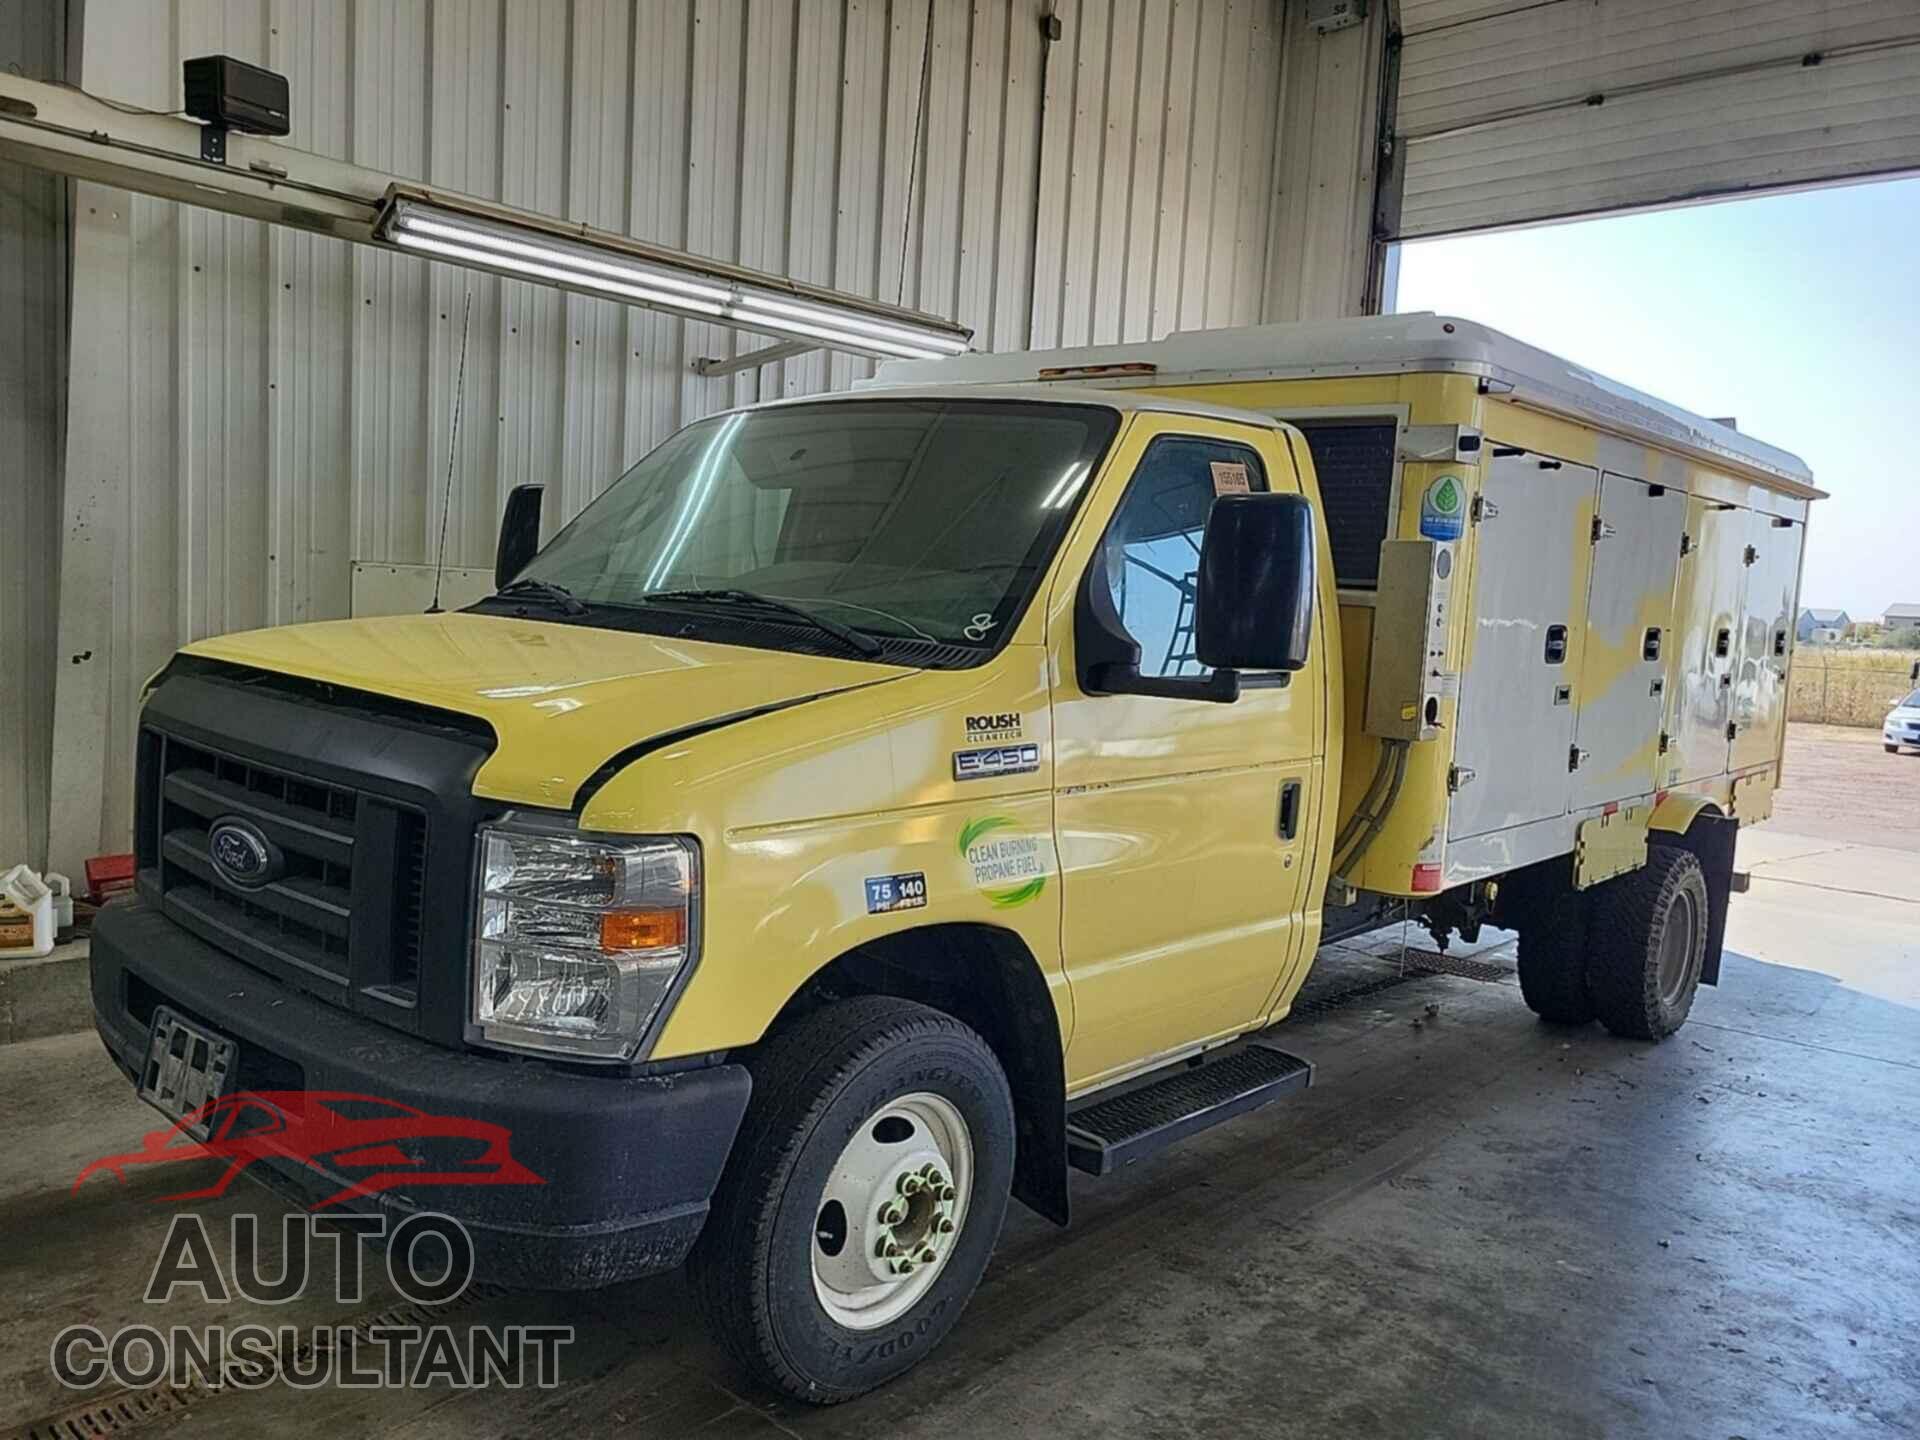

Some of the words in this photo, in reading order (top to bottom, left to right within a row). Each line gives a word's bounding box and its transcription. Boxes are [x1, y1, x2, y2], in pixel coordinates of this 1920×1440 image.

[965, 712, 1021, 731] ROUSH
[217, 834, 248, 869] Ford
[968, 842, 999, 864] CLEAN
[999, 836, 1038, 858] BURNING
[975, 859, 1017, 883] PROPANE
[1016, 855, 1038, 875] FUEL
[871, 884, 892, 900] 75
[899, 880, 923, 897] 140
